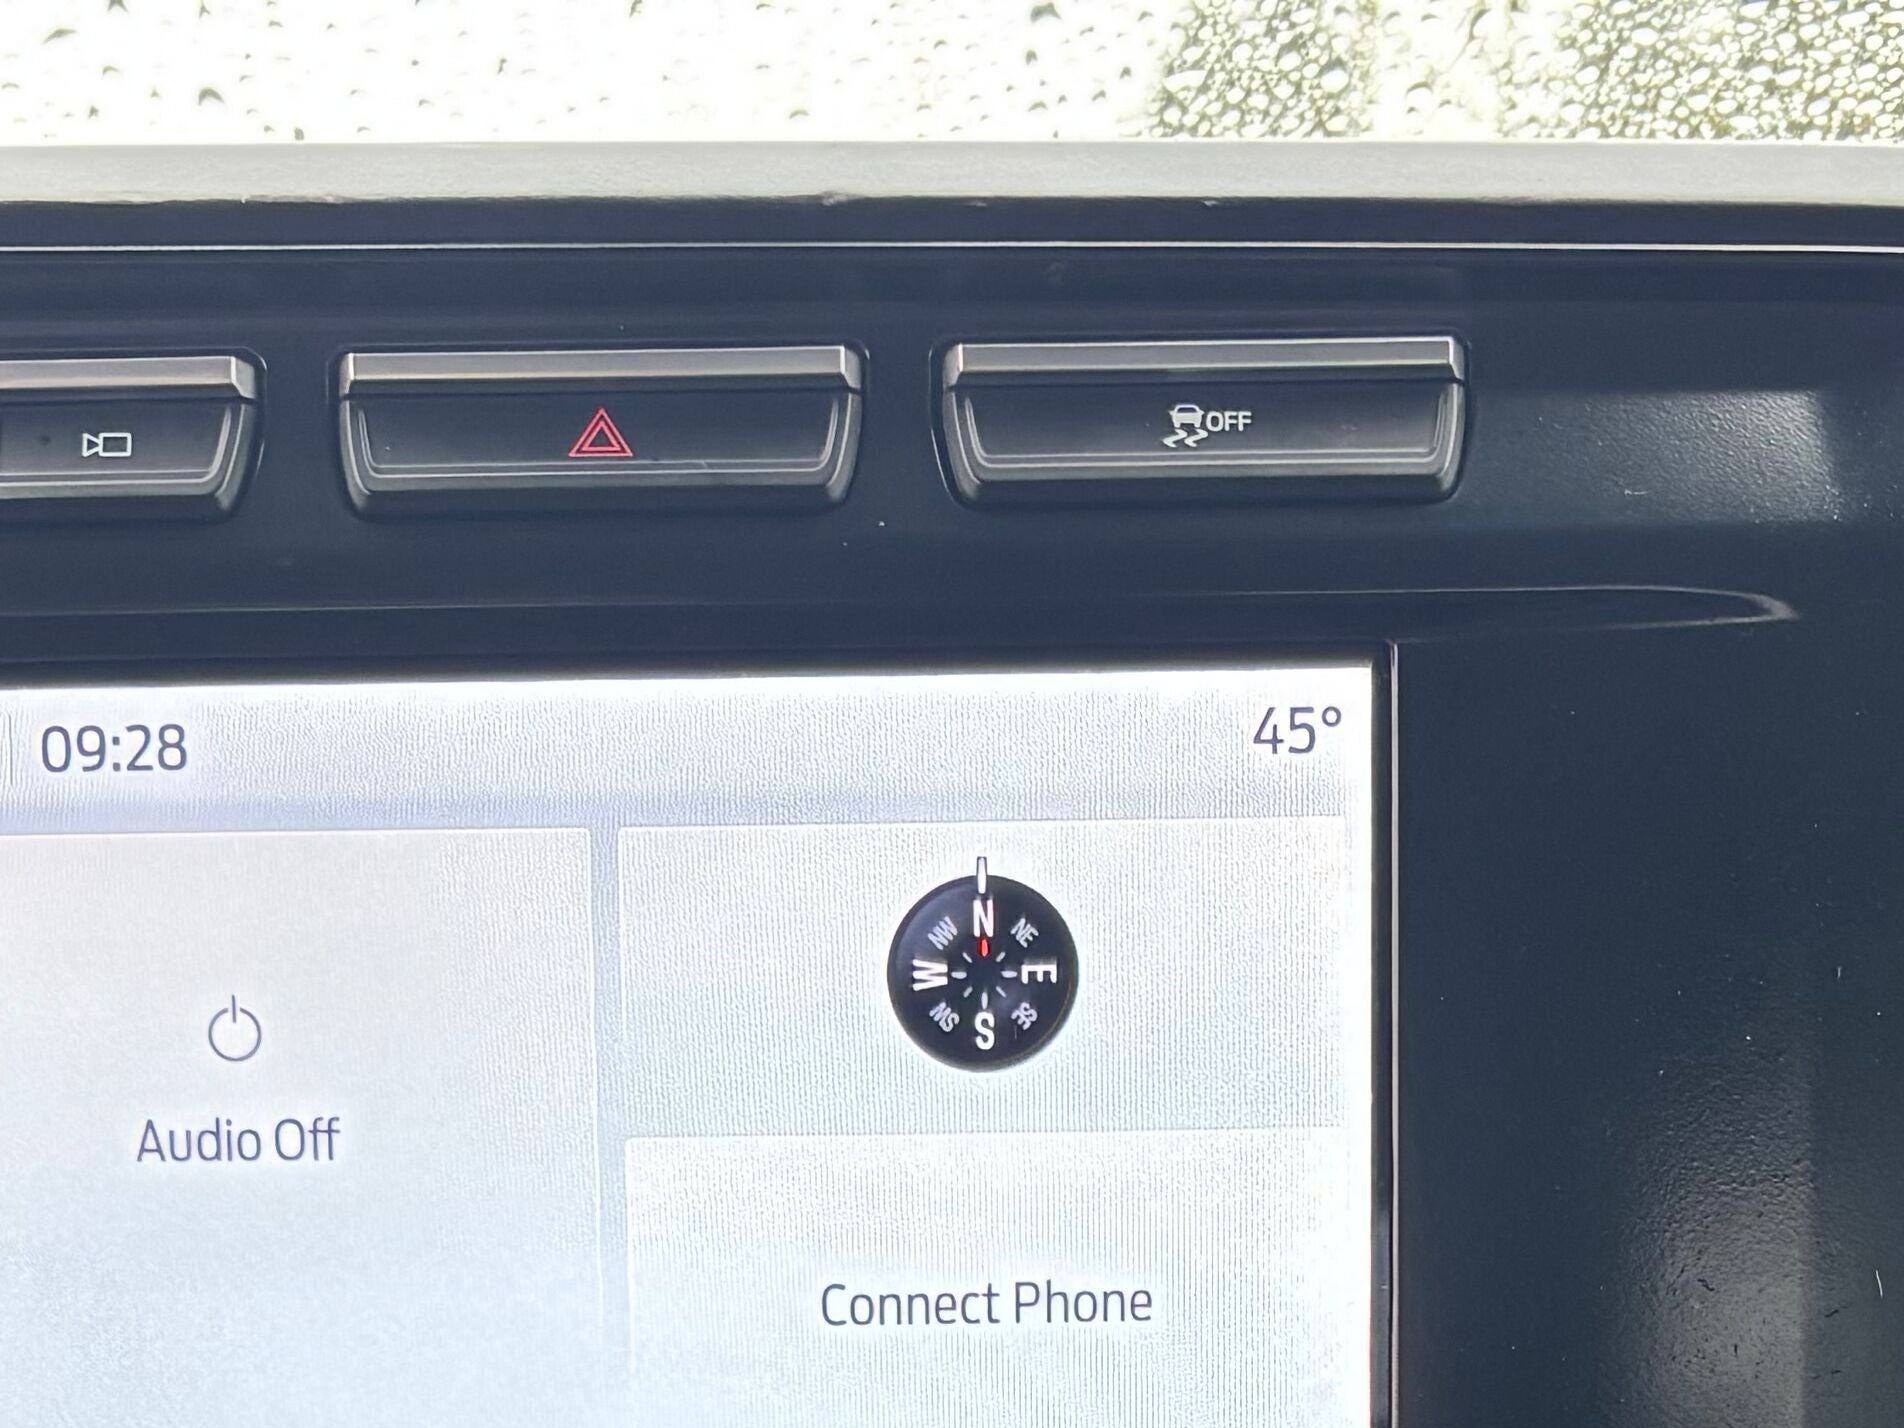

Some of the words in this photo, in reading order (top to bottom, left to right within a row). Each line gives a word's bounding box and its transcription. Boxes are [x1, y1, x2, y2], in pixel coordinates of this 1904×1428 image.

[1205, 410, 1252, 432] OFF
[41, 723, 187, 773] 09:28
[1253, 706, 1342, 755] 45°
[927, 915, 958, 950] NW
[972, 898, 994, 938] N
[1010, 917, 1039, 948] NE
[912, 959, 948, 991] W
[1021, 962, 1058, 984] E
[929, 1001, 960, 1033] SW
[974, 1011, 995, 1050] S
[1011, 1001, 1038, 1030] SE
[136, 1116, 262, 1162] Audio
[274, 1116, 341, 1161] Off
[821, 1282, 1001, 1327] Connect
[1015, 1279, 1152, 1324] Phone
